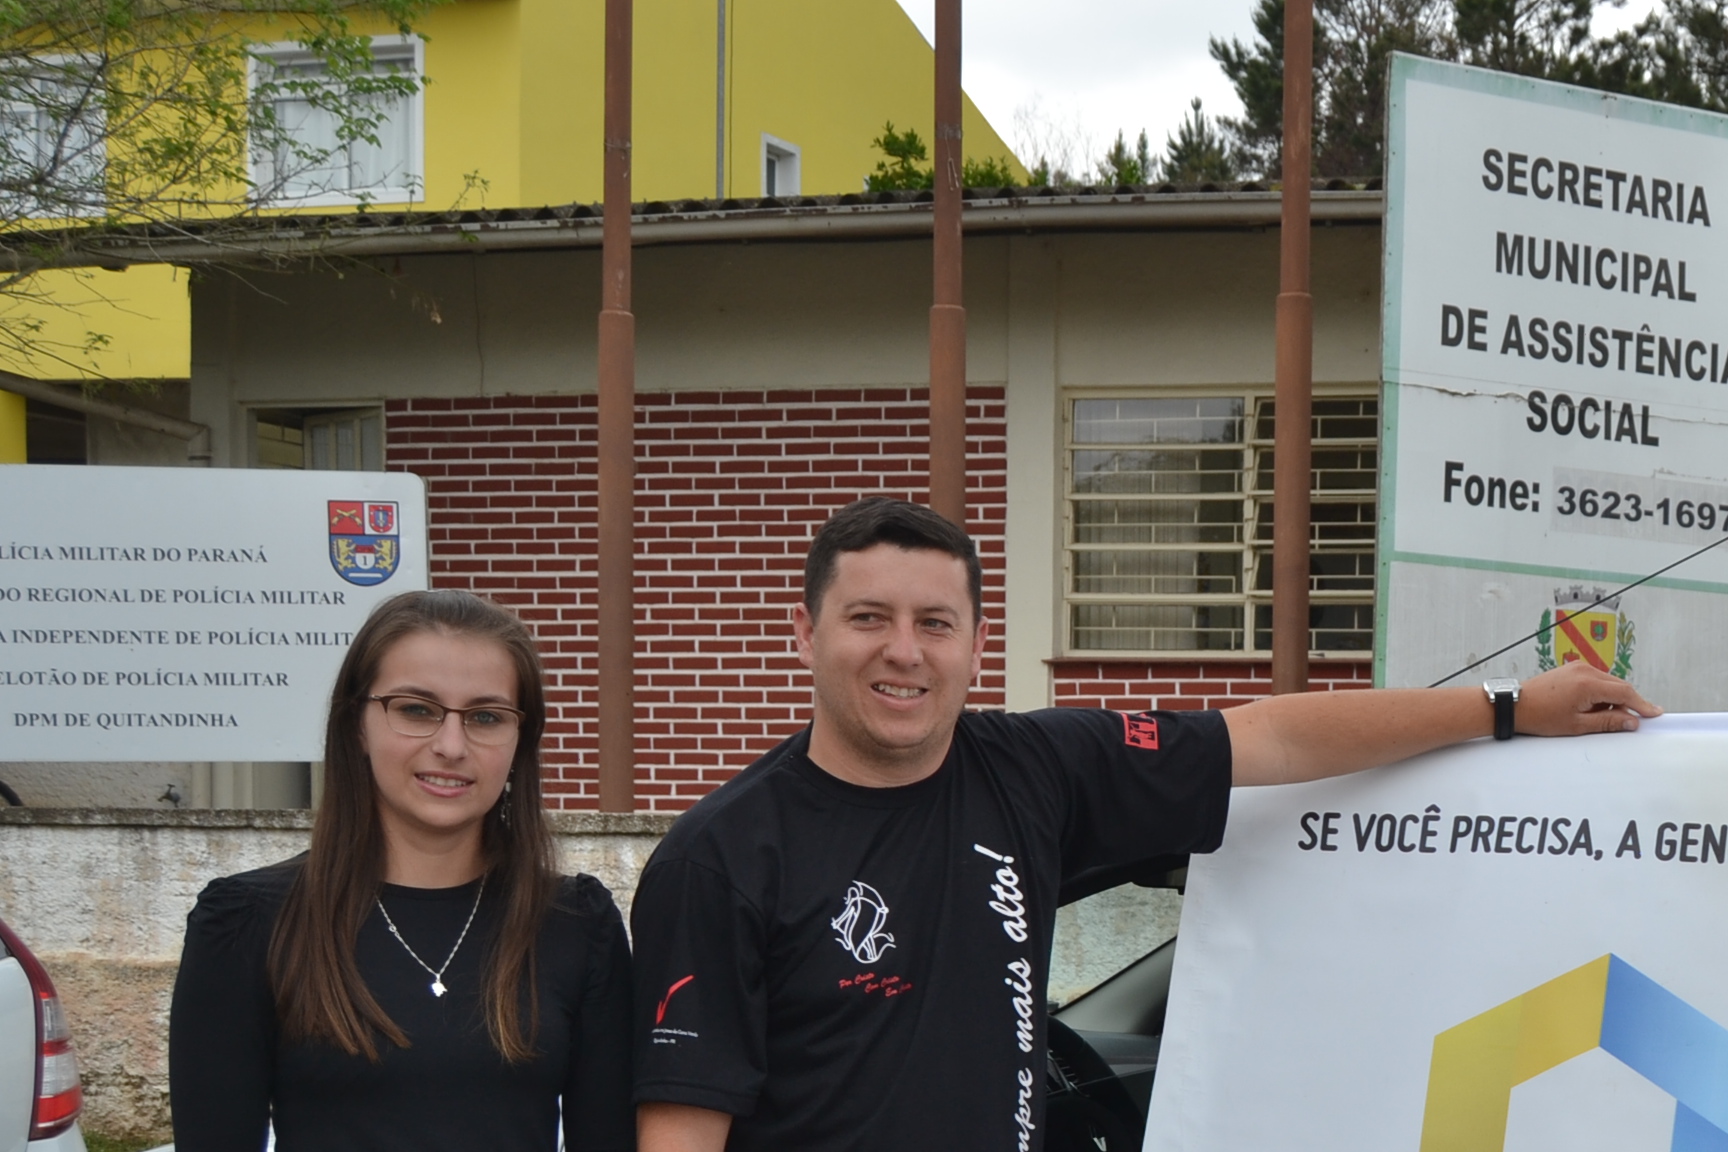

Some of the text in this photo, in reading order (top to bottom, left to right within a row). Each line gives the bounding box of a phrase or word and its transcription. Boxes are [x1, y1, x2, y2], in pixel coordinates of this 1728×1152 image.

[1481, 147, 1712, 228] SECRETARIA
[1495, 230, 1698, 303] MUNICIPAL
[1440, 303, 1489, 353] DE
[1525, 389, 1660, 447] SOCIAL
[1442, 459, 1541, 513] Fone:
[58, 545, 147, 562] MILITAR
[152, 547, 182, 562] DO
[187, 545, 268, 563] PARANÁ
[27, 587, 136, 603] REGIONAL
[140, 588, 167, 603] DE
[172, 585, 256, 605] POLÍCIA
[260, 590, 346, 606] MILITAR
[12, 628, 170, 645] INDEPENDENTE
[175, 630, 202, 645] DE
[207, 627, 290, 646] POLÍCIA
[295, 631, 353, 647] MILIT
[82, 671, 110, 686] DE
[115, 667, 199, 687] POLÍCIA
[203, 671, 290, 688] MILITAR
[13, 712, 239, 731] DPM DE QUITANDINHA
[1297, 811, 1340, 853] SE
[1352, 803, 1441, 854] VOCÊ
[1449, 813, 1603, 862] PRECISA,
[1615, 819, 1643, 860] A
[973, 842, 1029, 943] alto!
[1006, 956, 1034, 1054] mais
